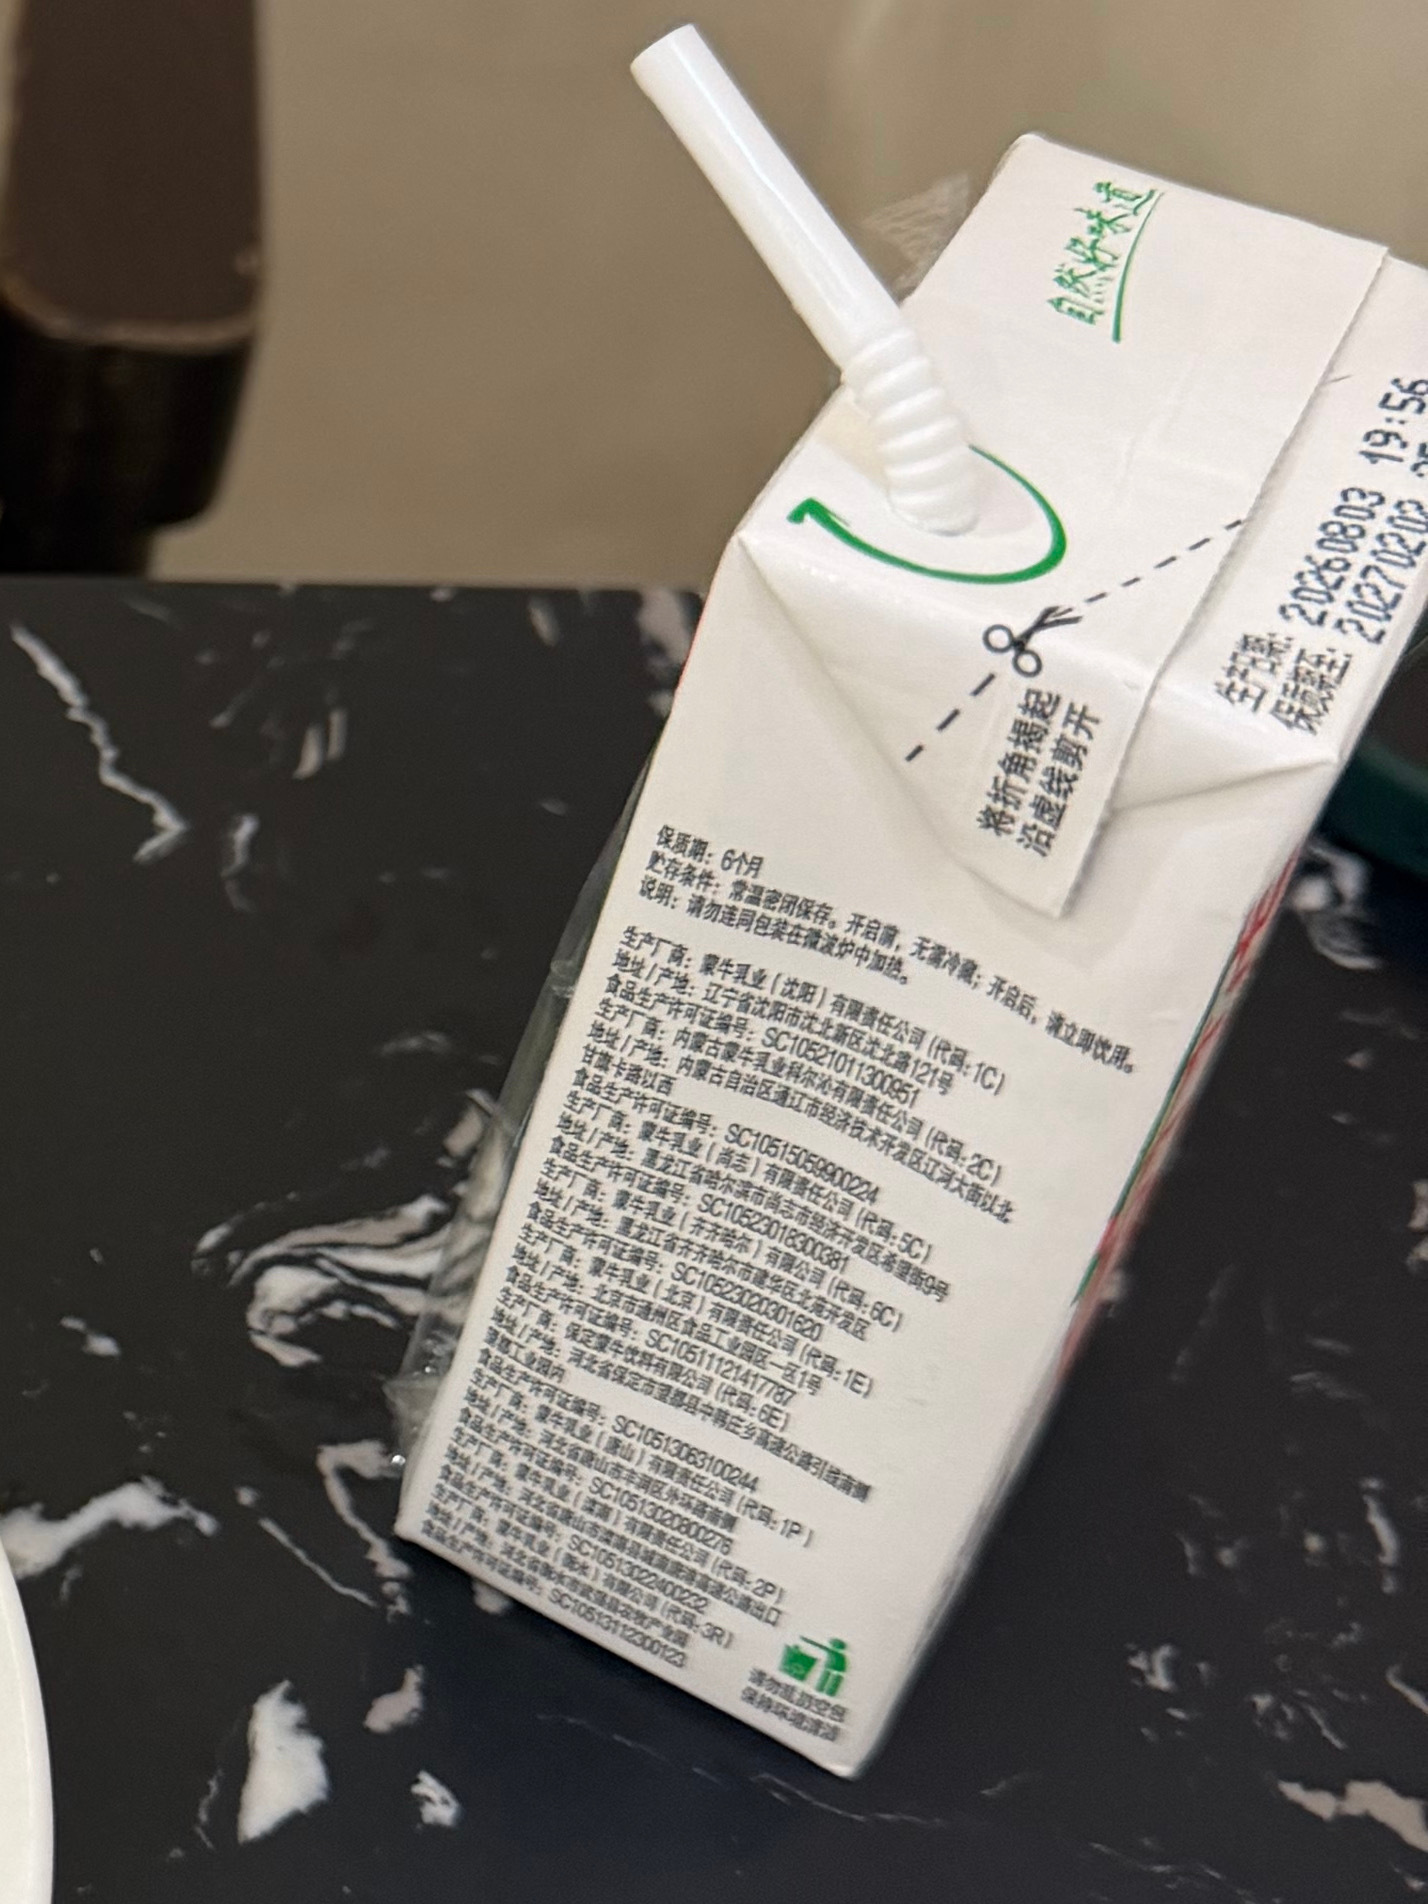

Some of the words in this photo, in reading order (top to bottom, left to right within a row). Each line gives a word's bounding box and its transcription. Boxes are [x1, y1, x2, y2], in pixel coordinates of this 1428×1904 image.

[1278, 486, 1387, 627] 20260803
[976, 688, 1063, 837] 将折角揭起
[1016, 702, 1103, 858] 沿虚线剪开
